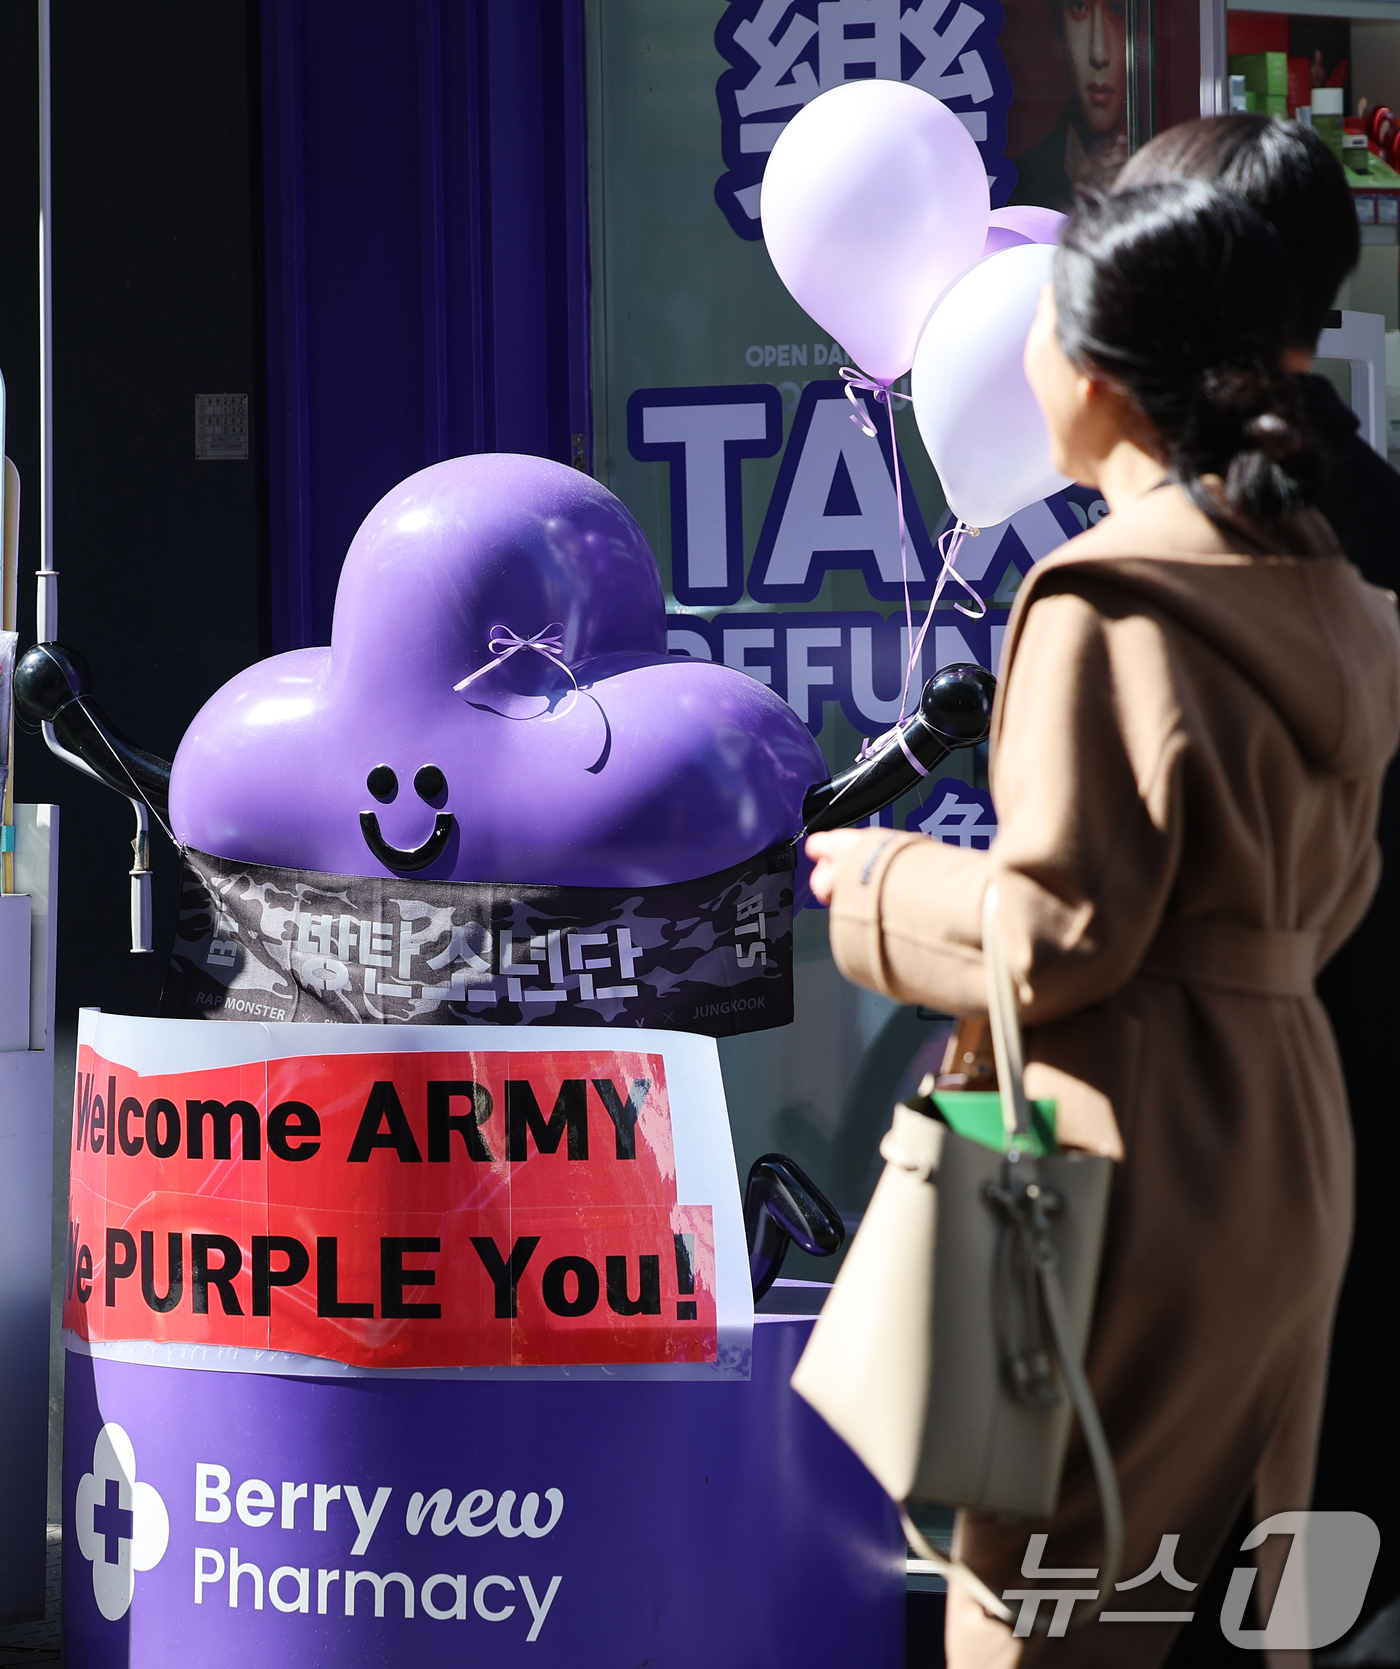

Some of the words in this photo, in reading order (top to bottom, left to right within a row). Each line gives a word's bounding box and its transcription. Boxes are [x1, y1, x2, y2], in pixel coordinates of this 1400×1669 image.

[745, 343, 808, 367] OPEN
[813, 342, 854, 366] DAI
[206, 901, 239, 967] BT
[299, 912, 643, 1002] 방탄소년단
[734, 892, 767, 968] BTS
[195, 991, 223, 1006] RAP
[224, 996, 286, 1021] MONSTER
[693, 996, 766, 1019] JUNGKOOK
[76, 1071, 321, 1163] Welcome
[346, 1078, 652, 1163] ARMY
[105, 1227, 443, 1320] PURPLE
[472, 1232, 699, 1321] You!
[194, 1462, 392, 1555] Berry
[405, 1487, 564, 1538] new
[193, 1547, 563, 1642] Pharmacy
